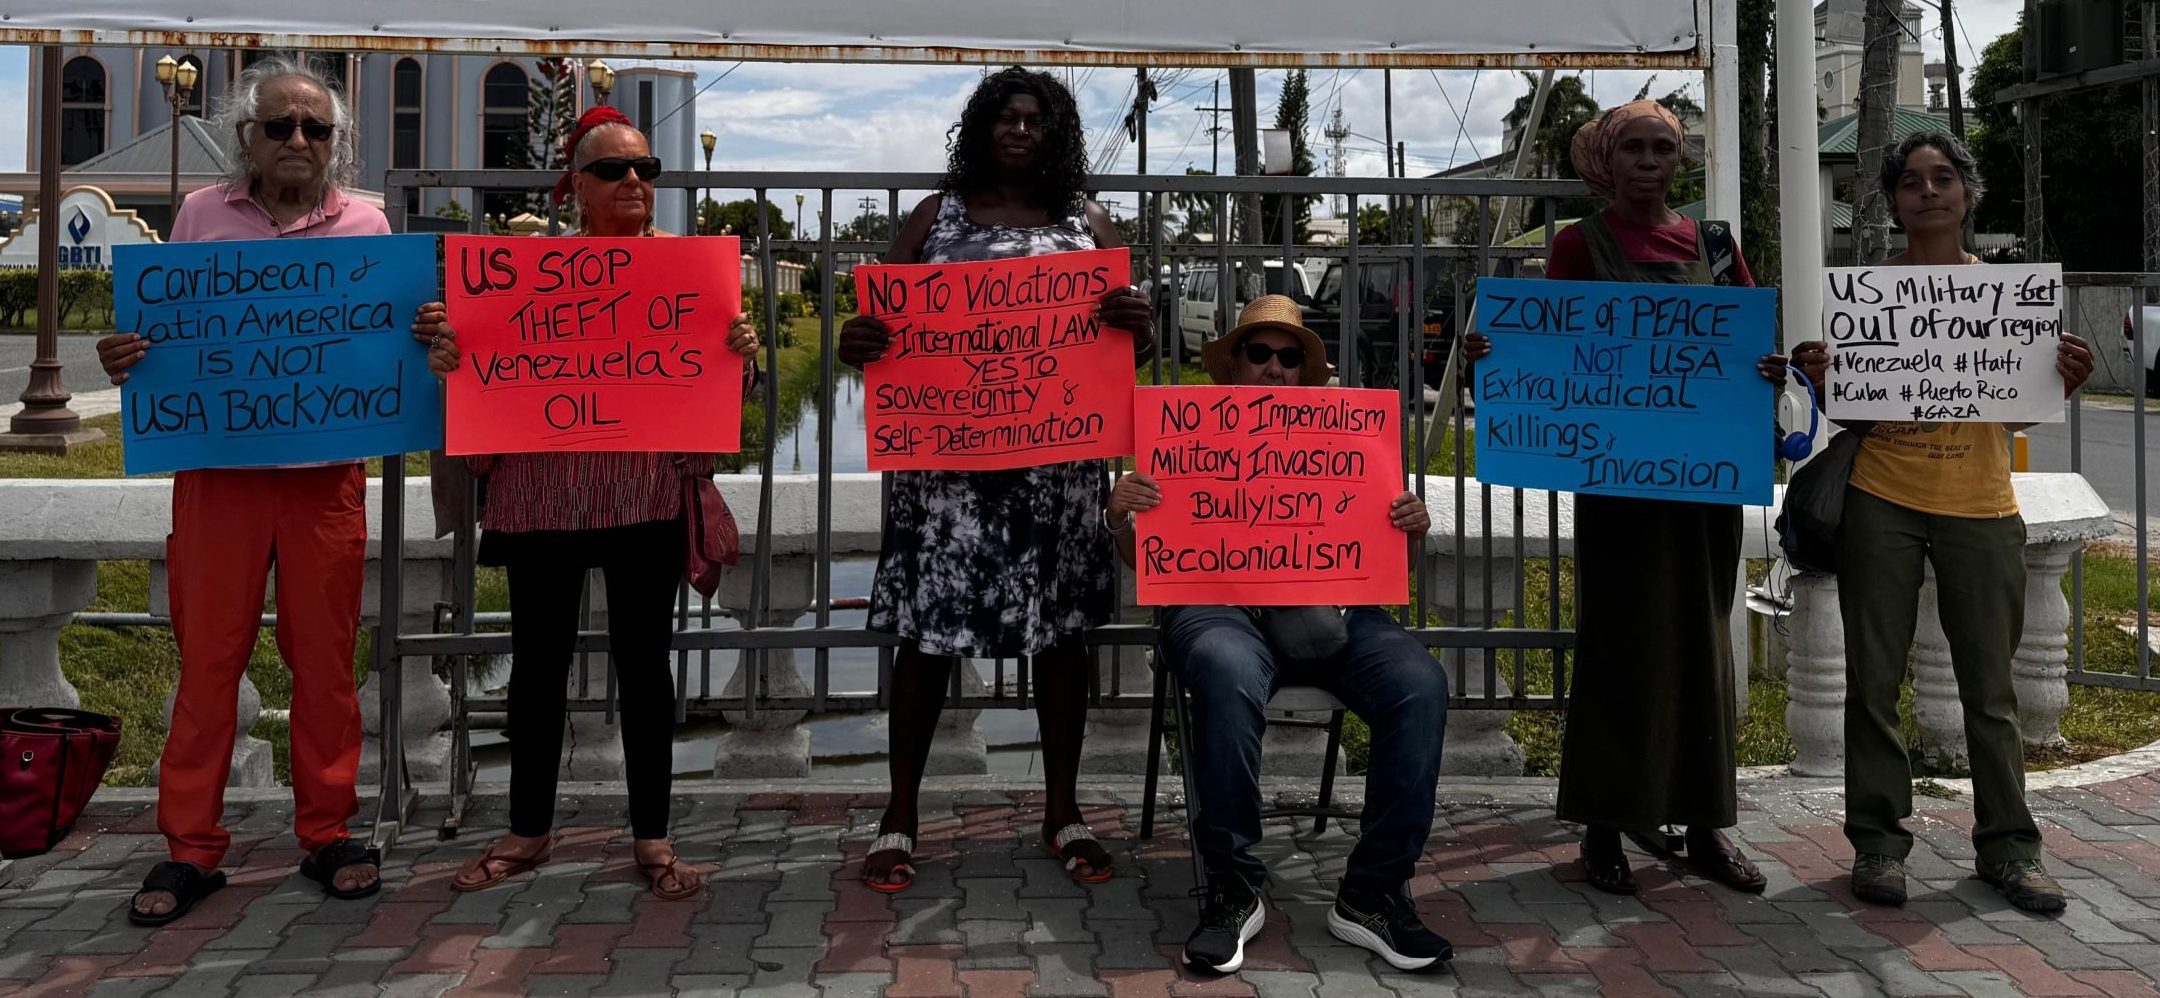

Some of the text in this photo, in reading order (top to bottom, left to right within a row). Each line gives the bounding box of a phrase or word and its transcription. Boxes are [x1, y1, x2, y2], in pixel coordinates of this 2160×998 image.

[58, 245, 101, 263] GBTI
[461, 246, 632, 295] US STOP
[137, 251, 334, 305] Caribbean
[867, 272, 907, 316] NO
[964, 265, 1109, 312] Violations
[1828, 271, 1884, 304] US
[508, 290, 699, 342] THEFT OF
[892, 313, 1100, 359] International LAW
[1486, 295, 1585, 331] ZONE
[1627, 295, 1740, 338] PEACE
[1830, 305, 1906, 341] OUT
[1910, 308, 1950, 339] of
[1949, 315, 1998, 339] our
[198, 338, 351, 377] IS NOT
[471, 340, 702, 386] Venezuela's
[963, 350, 1058, 386] YES TO
[1573, 343, 1723, 376] NOT USA
[1830, 348, 1945, 374] #Venezuela
[132, 359, 403, 435] USA Backyard
[876, 382, 1042, 419] Sovereignty
[1483, 367, 1697, 411] Extrajudicial
[1832, 382, 1889, 401] #Cuba
[1976, 380, 2018, 400] Rico
[544, 392, 621, 430] OIL
[1161, 399, 1200, 435] NO
[1247, 394, 1386, 440] Imperialism
[1910, 404, 1981, 420] #GAZA
[873, 412, 1104, 457] Self-Determination
[1488, 413, 1599, 457] Killings
[1151, 439, 1364, 482] Military Invasion
[1580, 453, 1740, 490] Invasion
[1190, 485, 1323, 528] Bullyism
[1141, 530, 1361, 576] Recolonialism
